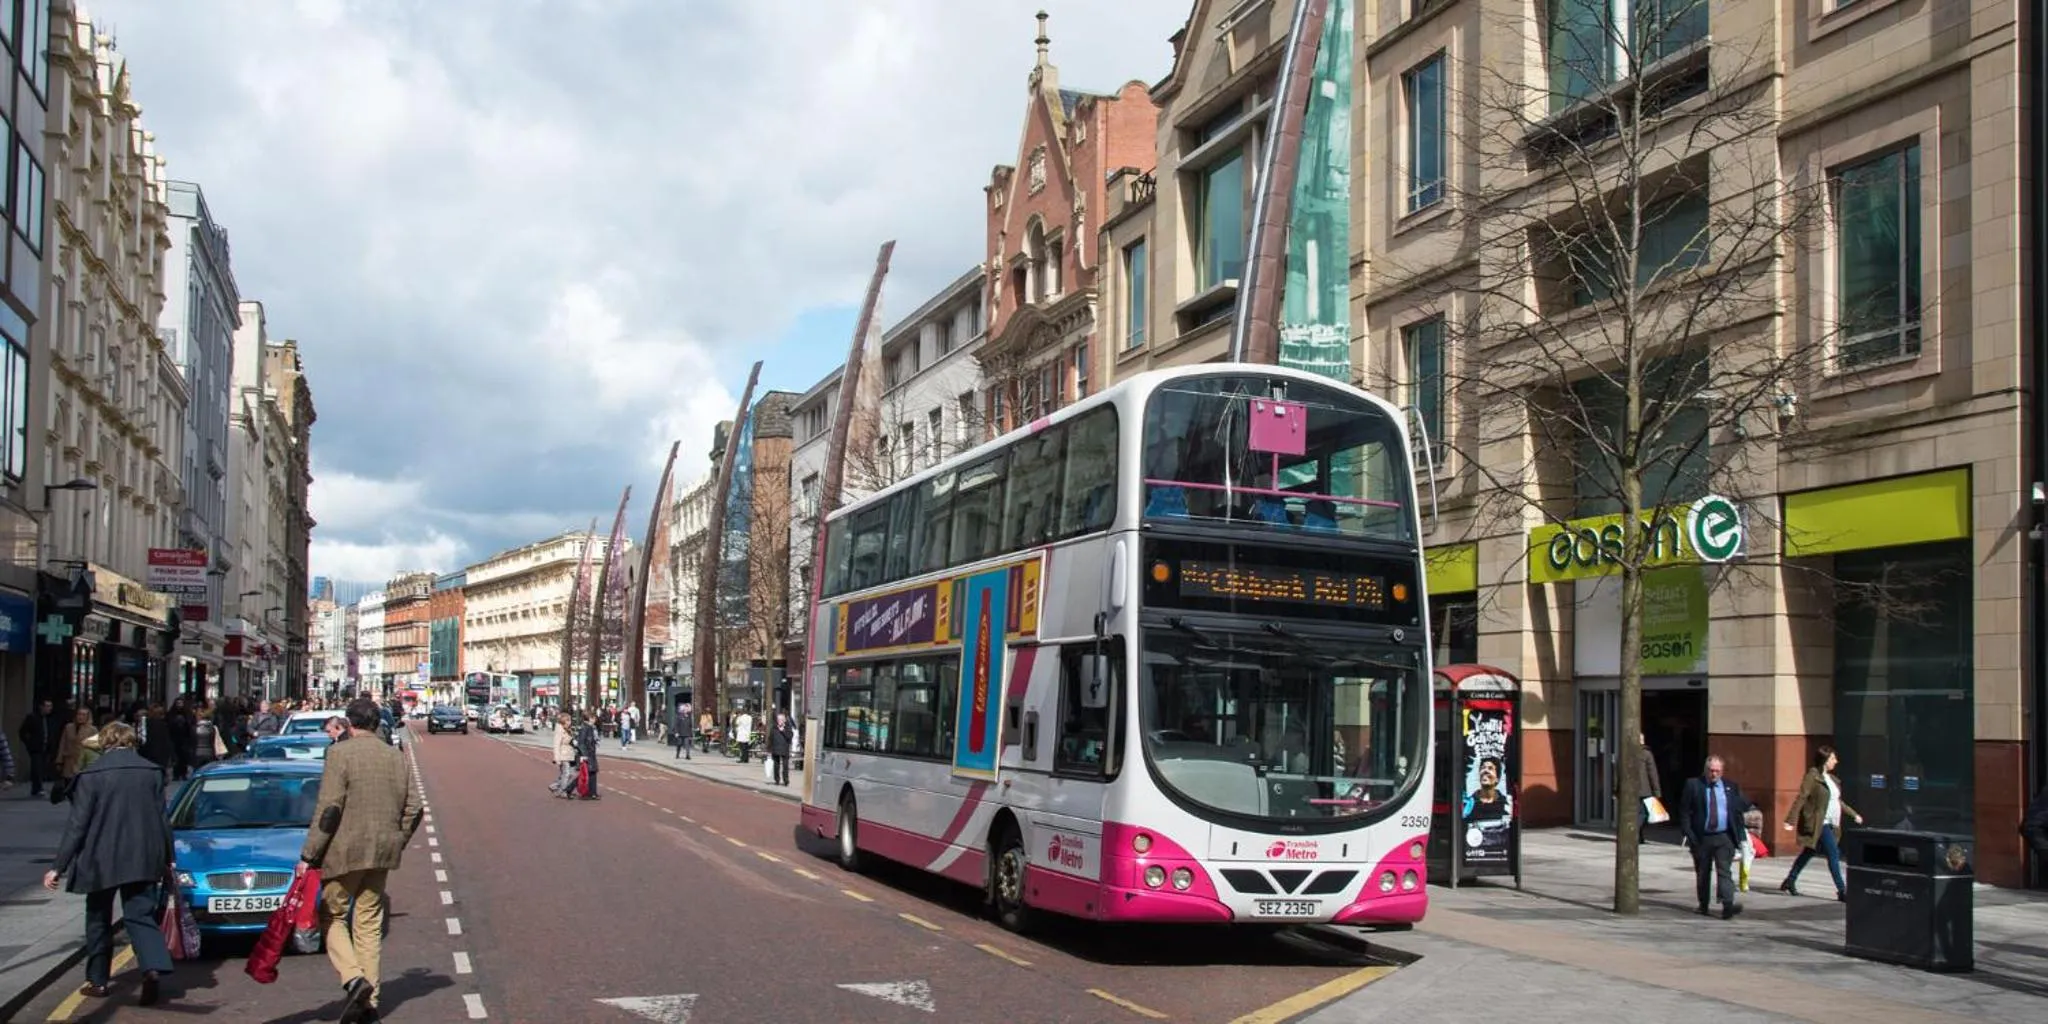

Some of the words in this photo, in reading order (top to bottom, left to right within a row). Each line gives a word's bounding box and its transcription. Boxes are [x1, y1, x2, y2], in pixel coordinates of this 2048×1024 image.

[1640, 640, 1693, 660] eason
[1401, 815, 1430, 828] 2350
[1286, 840, 1320, 849] Translink
[1061, 848, 1084, 870] Metro
[1285, 848, 1318, 860] Metro
[214, 898, 241, 911] EEZ
[245, 897, 281, 910] 6384
[1258, 902, 1281, 915] SEZ
[1284, 902, 1316, 915] 2350
